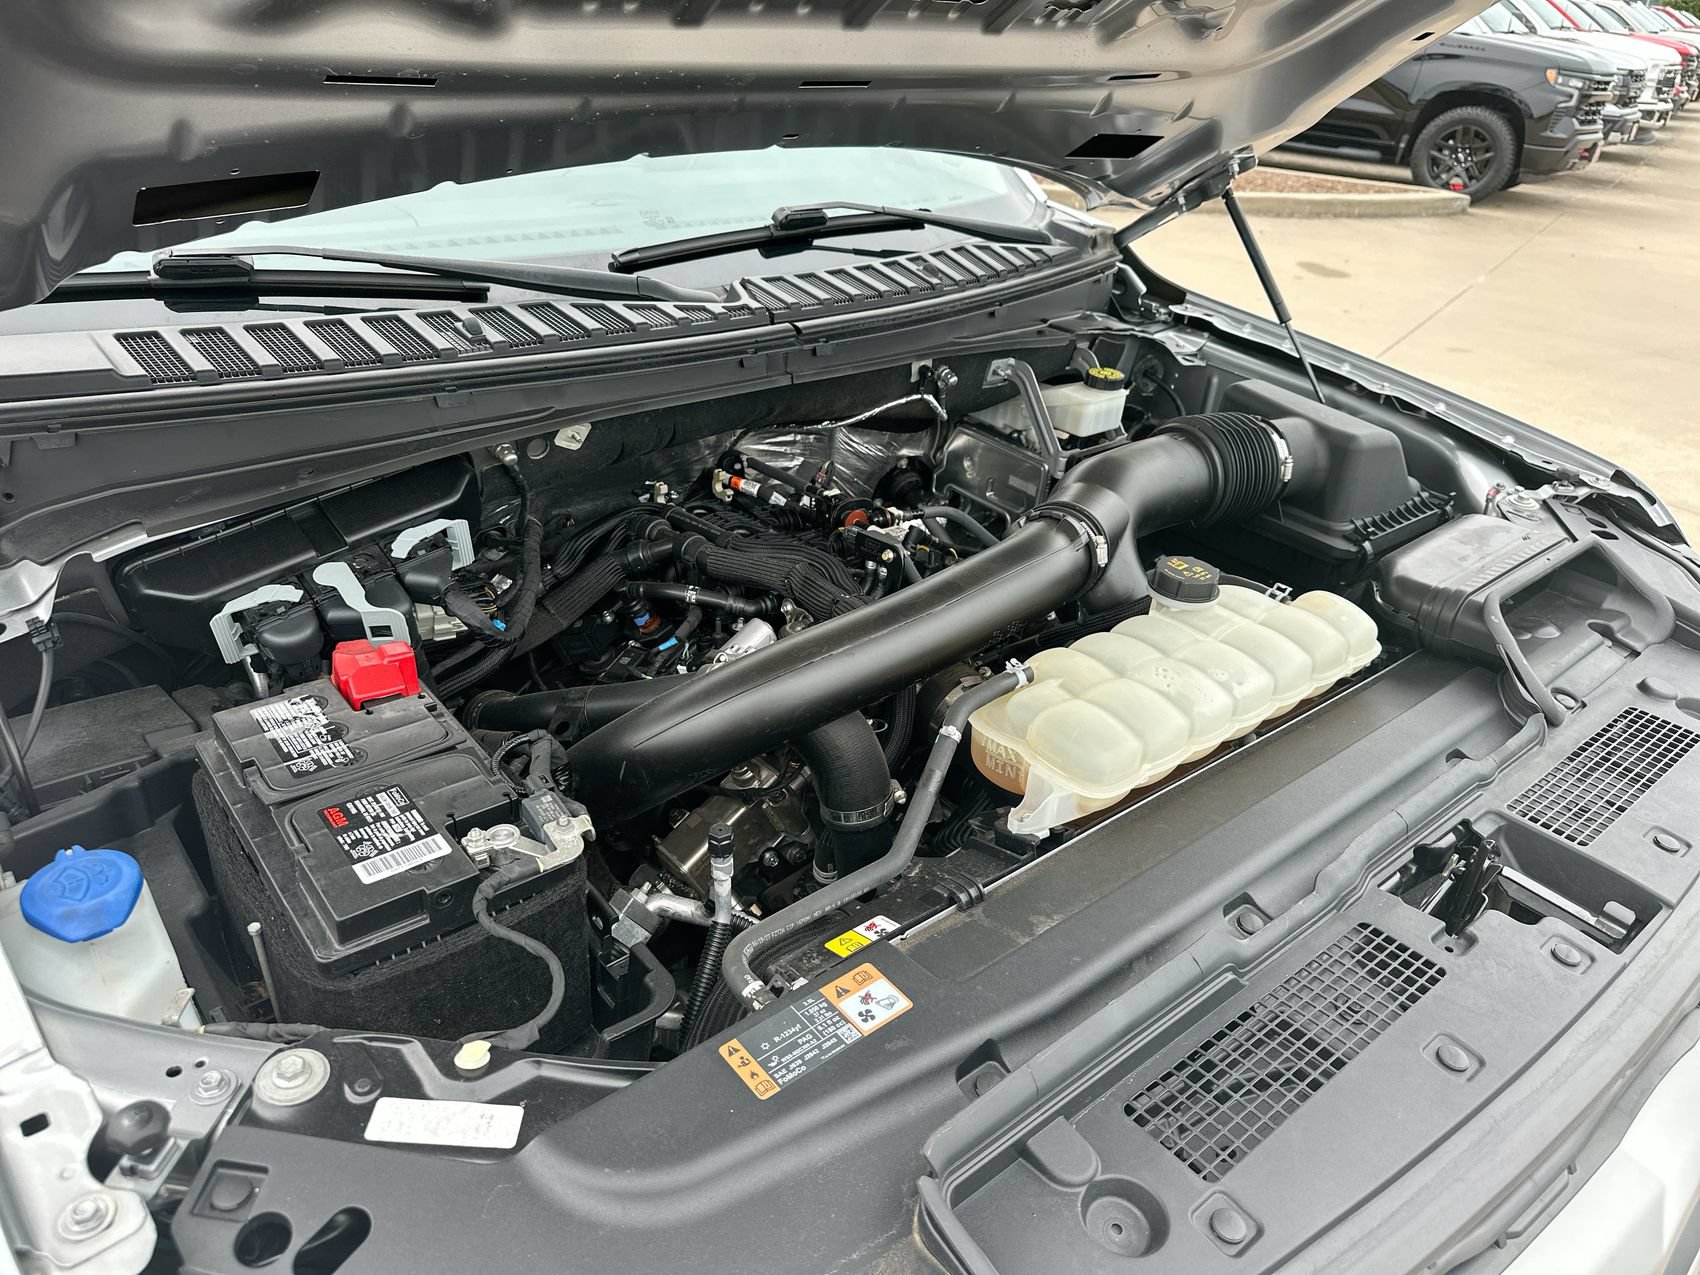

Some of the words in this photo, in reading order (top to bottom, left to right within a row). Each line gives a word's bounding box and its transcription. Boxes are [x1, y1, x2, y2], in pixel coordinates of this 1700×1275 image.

[986, 739, 1017, 762] MAX
[985, 755, 1017, 779] MIN
[328, 807, 349, 827] AGM
[817, 1001, 828, 1009] kg
[772, 1023, 803, 1043] R-1234yf
[796, 1033, 813, 1044] PAG
[773, 1068, 787, 1079] SAE
[777, 1064, 807, 1085] FoMoCo
